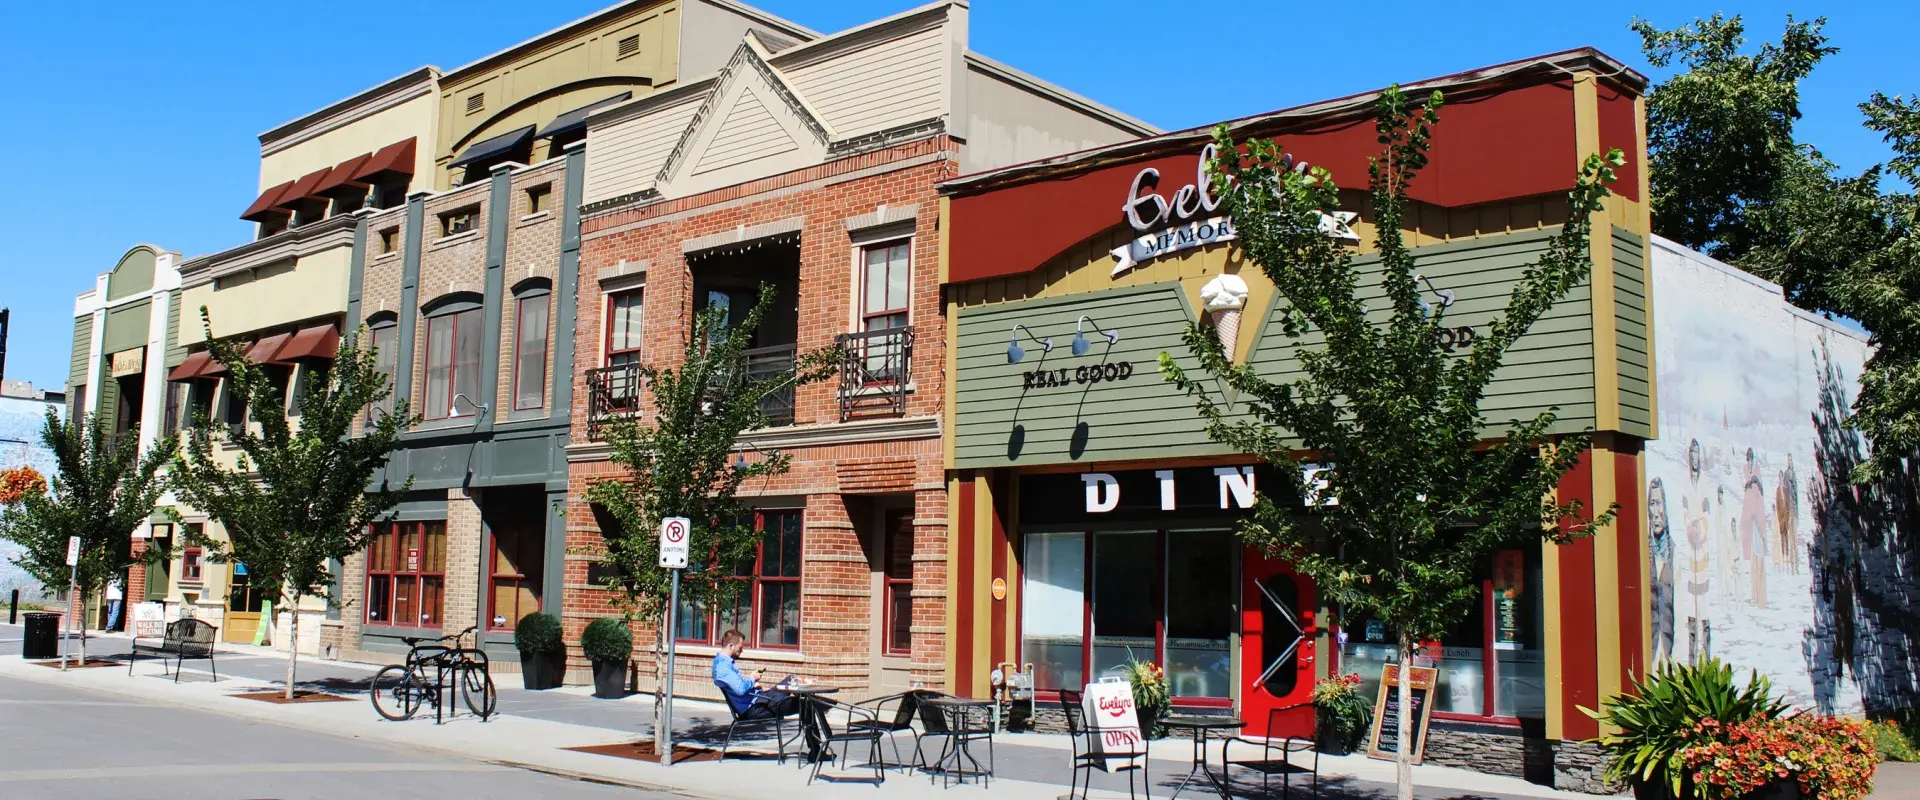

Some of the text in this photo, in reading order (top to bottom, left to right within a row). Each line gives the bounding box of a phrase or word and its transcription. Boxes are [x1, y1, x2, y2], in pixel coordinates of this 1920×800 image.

[1023, 361, 1133, 390] REAL GOOD
[1080, 463, 1427, 513] DINE
[1171, 640, 1210, 648] Homemade
[1447, 649, 1470, 657] Lunch
[1106, 730, 1139, 747] OPEN
